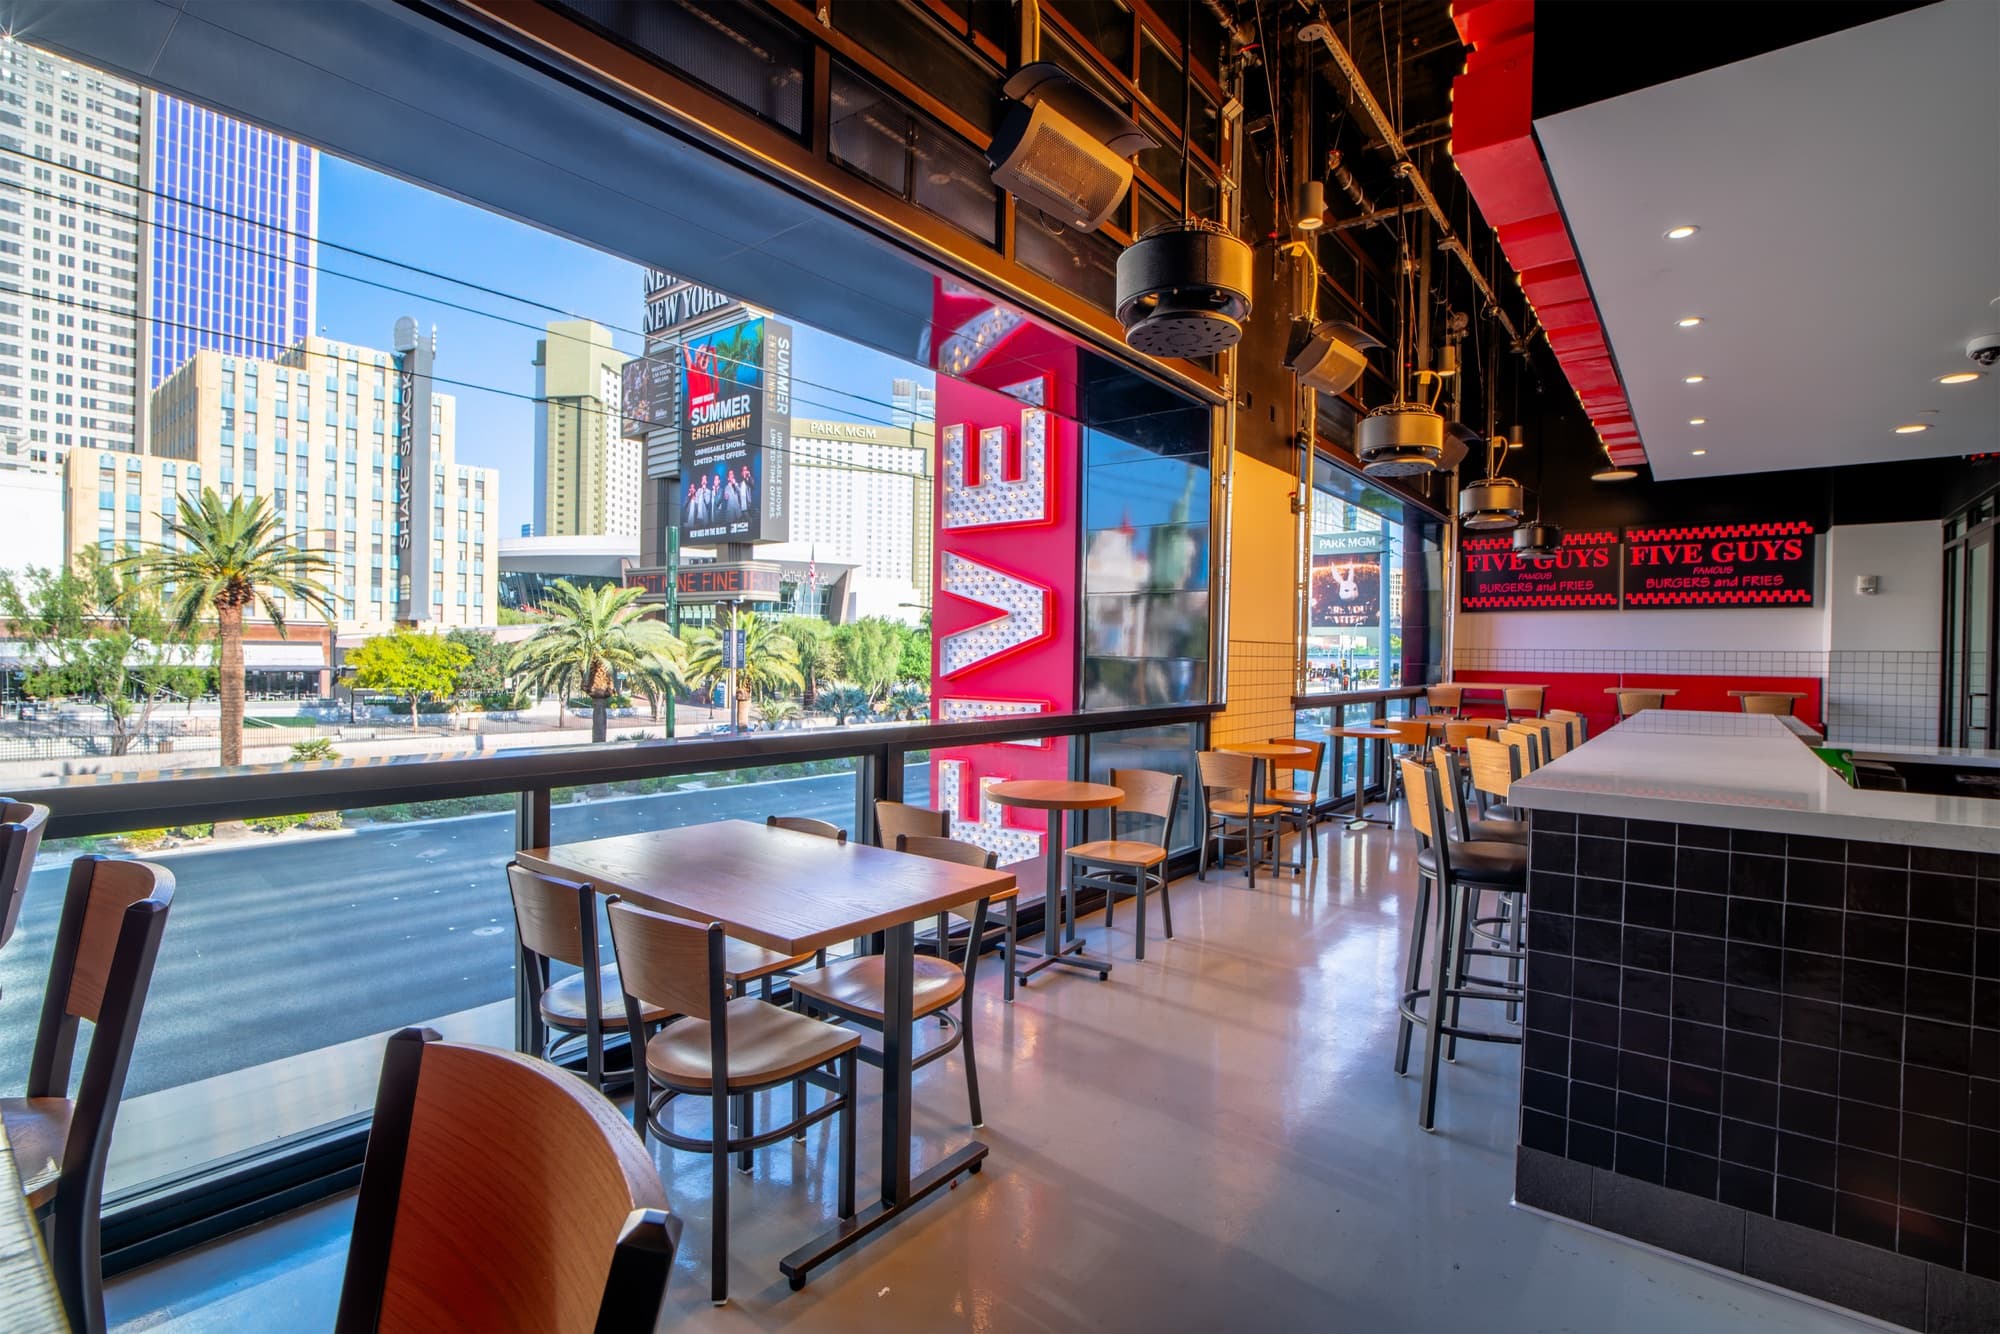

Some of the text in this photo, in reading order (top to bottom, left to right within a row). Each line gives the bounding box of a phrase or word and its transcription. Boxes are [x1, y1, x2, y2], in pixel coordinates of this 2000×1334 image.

[643, 292, 679, 334] NEW
[776, 336, 790, 415] SUMMER
[691, 394, 751, 426] SUMMER
[691, 414, 752, 441] ENTERTAINMENT
[810, 422, 877, 440] PARK MGM
[400, 369, 413, 549] SHAKE SHACK
[693, 454, 726, 467] LIMITED-TIME
[1319, 535, 1376, 549] PARK MGM
[1629, 538, 1803, 566] FIVE GUYS
[1465, 547, 1610, 573] FIVE GUYS
[1692, 566, 1734, 575] FAMOUS
[702, 570, 739, 592] FINE
[1479, 580, 1595, 593] BURGERS and FRIES
[1518, 572, 1553, 581] FAMOUS
[1646, 575, 1784, 589] BURGERS and FRIES
